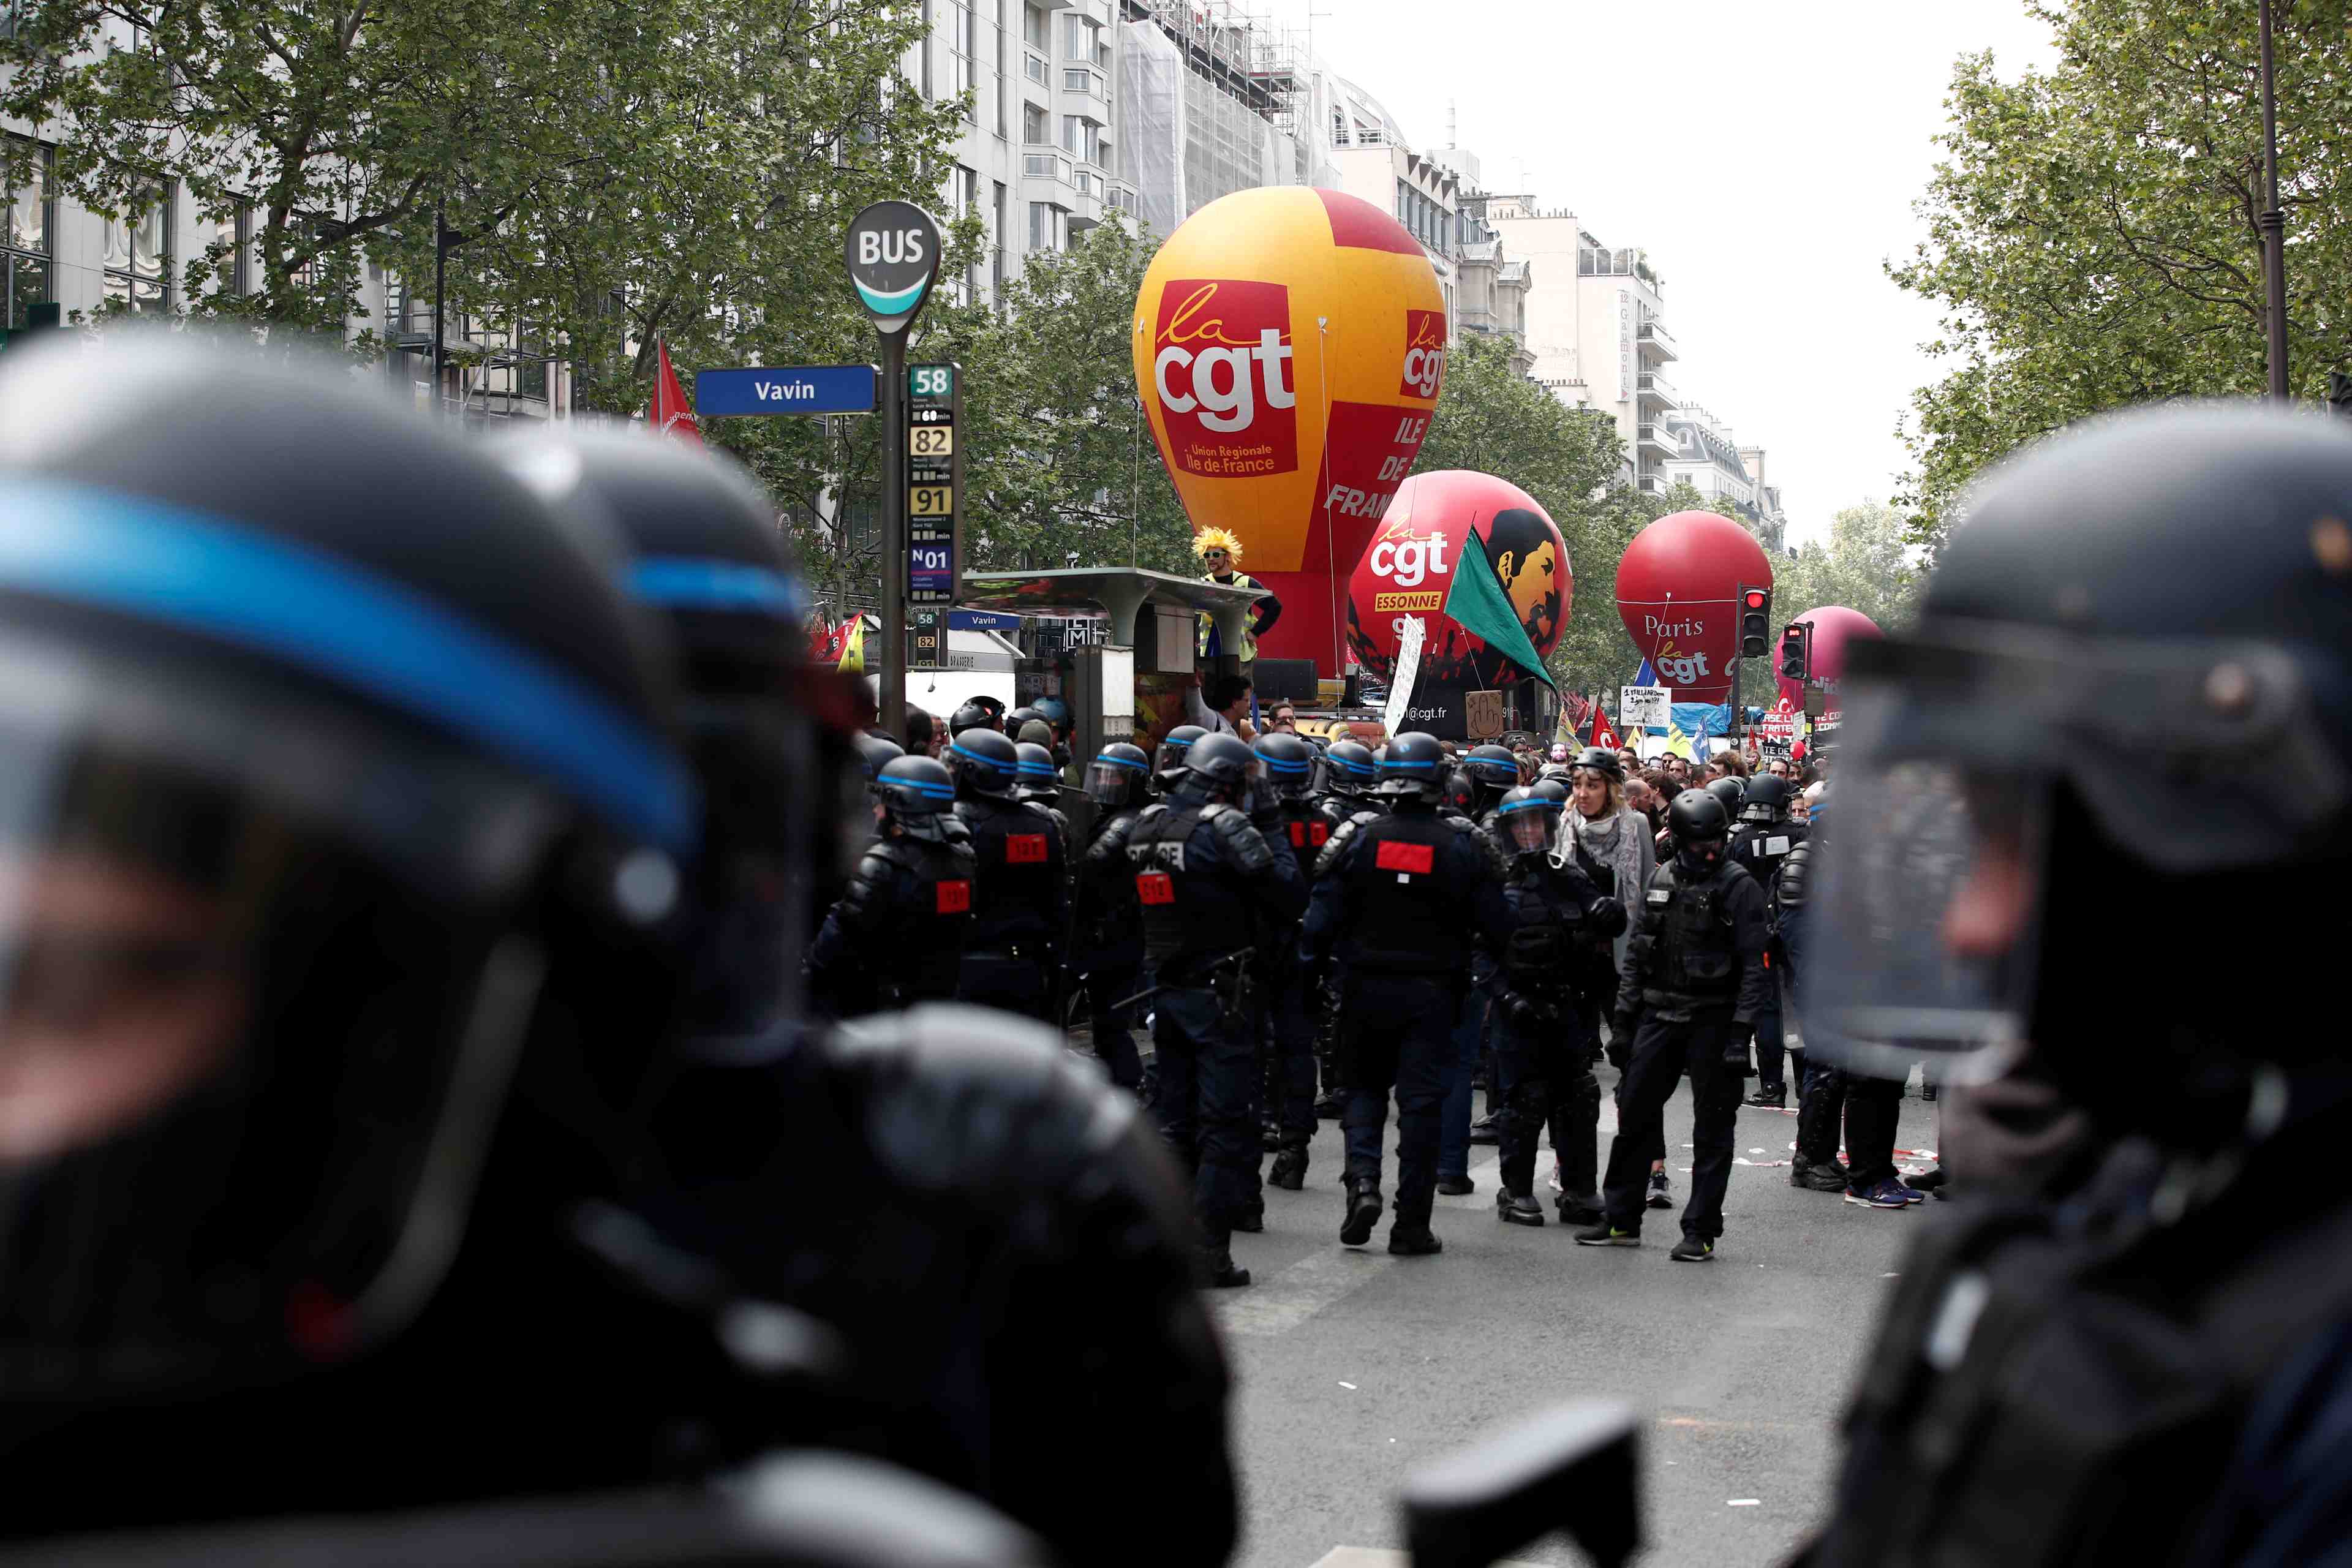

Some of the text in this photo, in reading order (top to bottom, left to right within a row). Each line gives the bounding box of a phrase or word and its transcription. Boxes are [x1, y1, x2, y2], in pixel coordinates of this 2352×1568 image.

[859, 228, 923, 264] BUS
[1157, 282, 1291, 345] la
[1410, 313, 1442, 349] la
[916, 369, 948, 393] 58
[1155, 328, 1296, 432] cgt
[1403, 341, 1445, 397] cgt
[755, 380, 815, 401] Vavin
[922, 410, 937, 421] 60
[916, 429, 946, 452] 82
[1393, 417, 1425, 444] ILE
[1191, 444, 1273, 460] Union Régionale
[1376, 456, 1408, 481] DE
[917, 489, 944, 513] 91
[1370, 531, 1448, 586] cgt
[1376, 595, 1439, 609] ESSONNE
[920, 614, 933, 624] 58
[1645, 615, 1703, 638] Paris
[920, 638, 933, 647] 82
[950, 655, 974, 668] BRASSERIE
[1657, 652, 1710, 684] cgt
